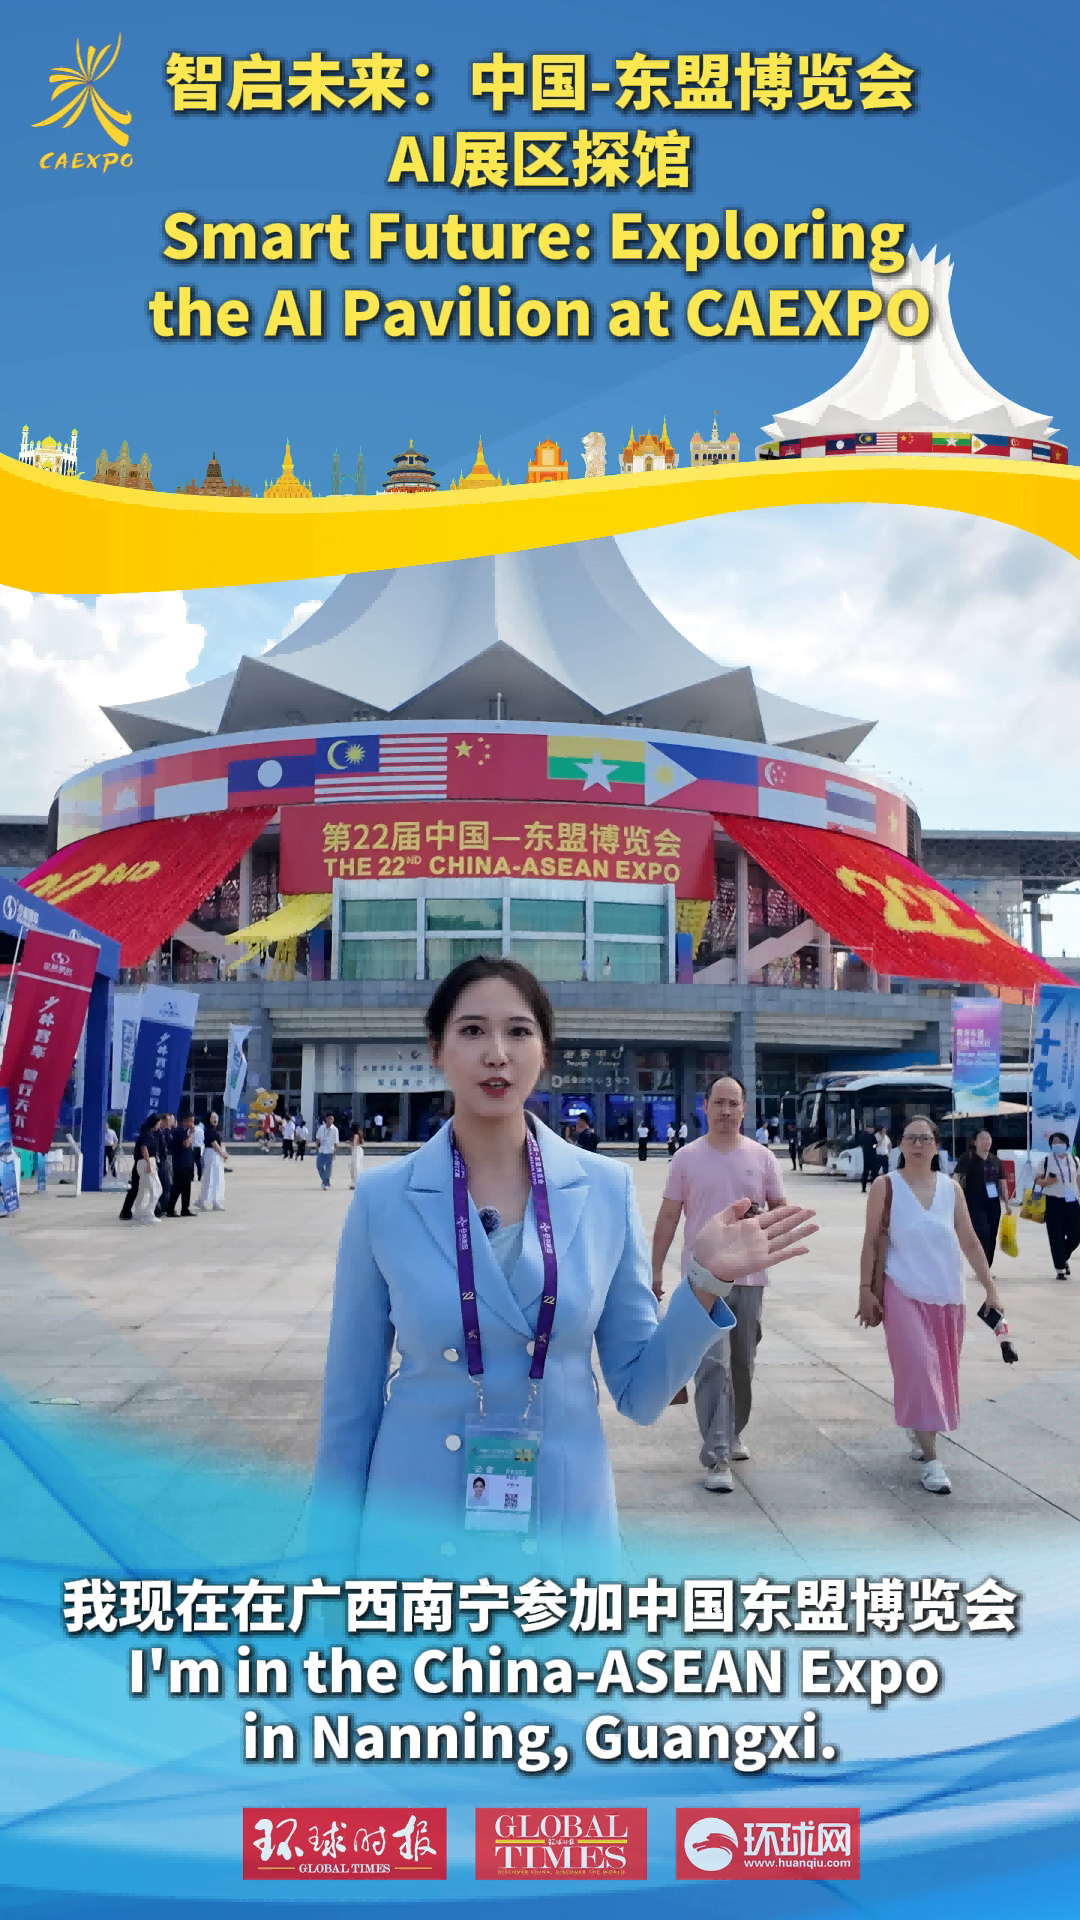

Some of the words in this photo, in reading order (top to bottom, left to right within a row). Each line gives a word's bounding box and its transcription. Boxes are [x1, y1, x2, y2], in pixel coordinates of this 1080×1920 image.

[323, 857, 372, 877] THE
[429, 855, 609, 879] CHINA-ASEAN
[615, 860, 681, 882] EXPO
